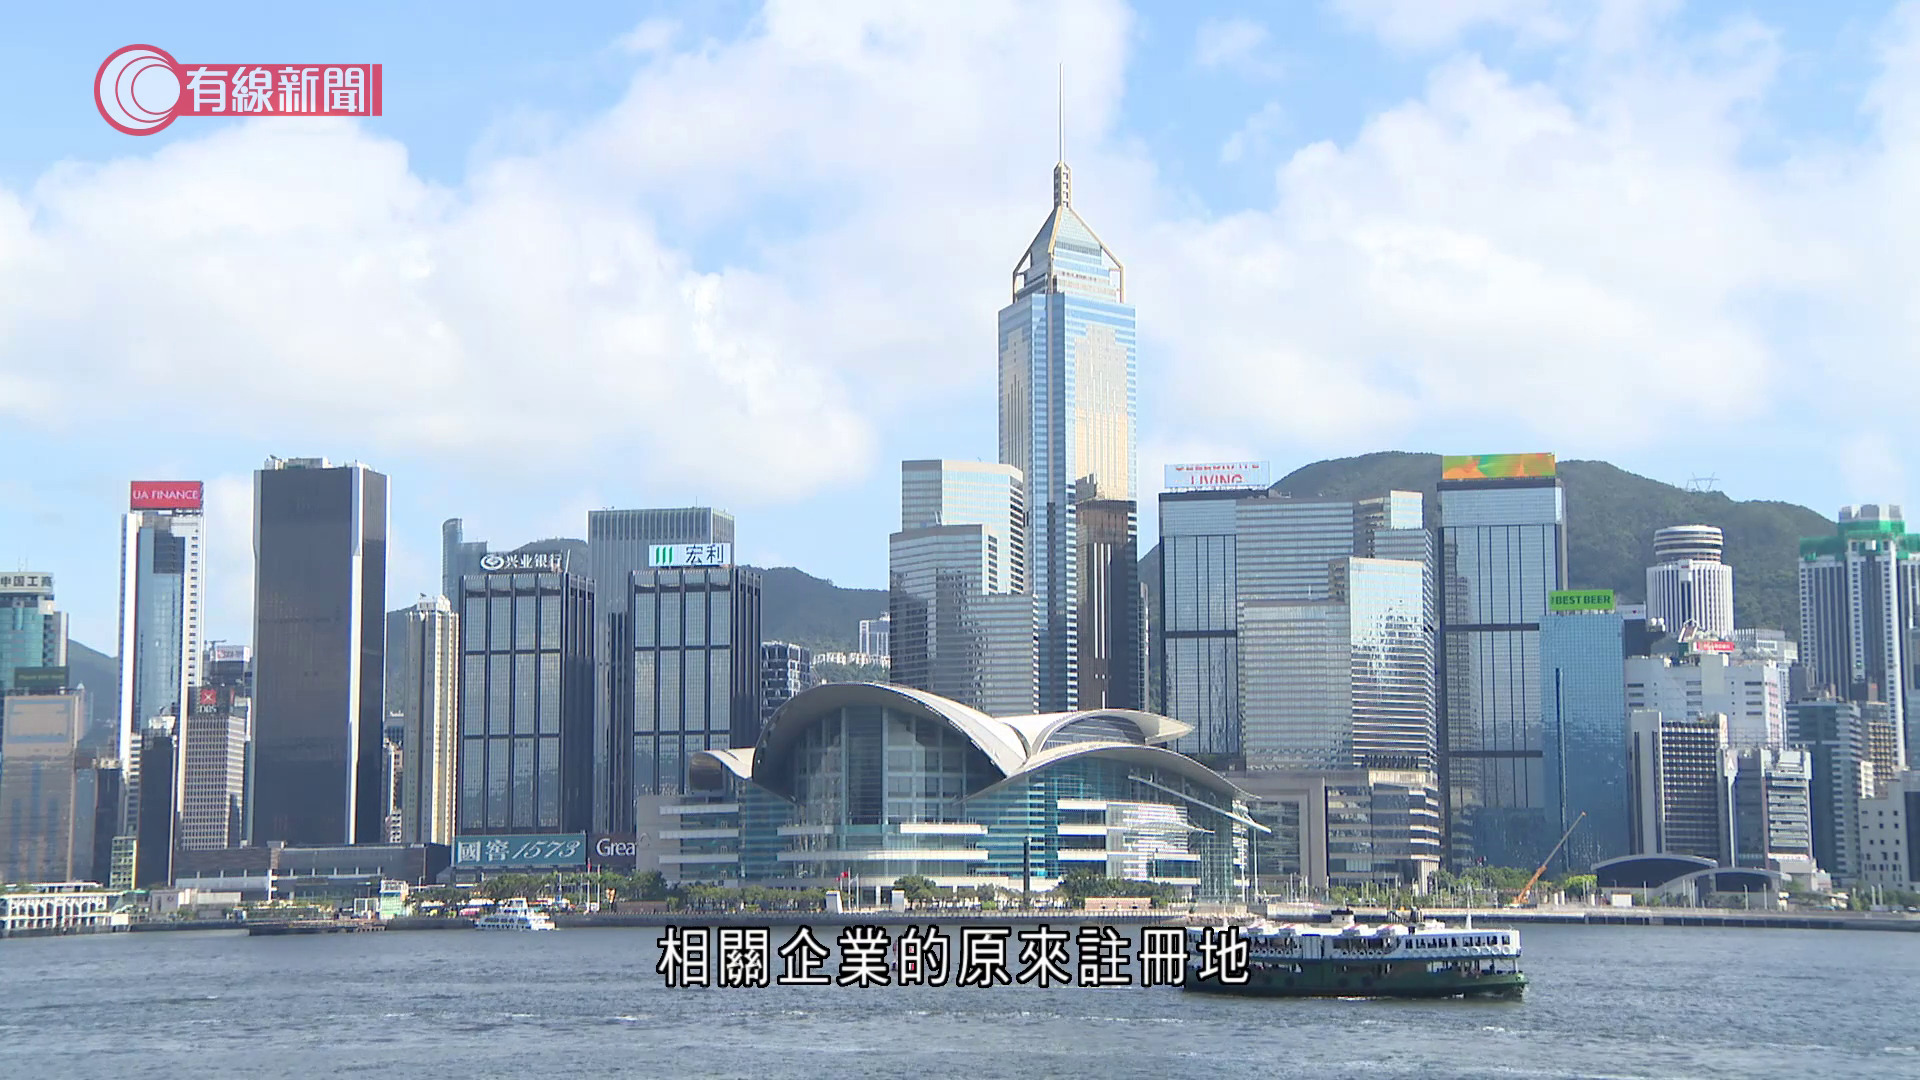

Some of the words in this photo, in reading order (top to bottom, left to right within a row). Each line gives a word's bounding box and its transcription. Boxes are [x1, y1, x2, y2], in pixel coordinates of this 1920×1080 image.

[132, 490, 149, 500] UA
[151, 490, 199, 500] FINANCE
[505, 553, 563, 570] 兴业银行
[686, 544, 724, 564] 宏利
[1556, 595, 1582, 605] BEST
[1584, 594, 1611, 604] BEER
[596, 838, 636, 857] Grea
